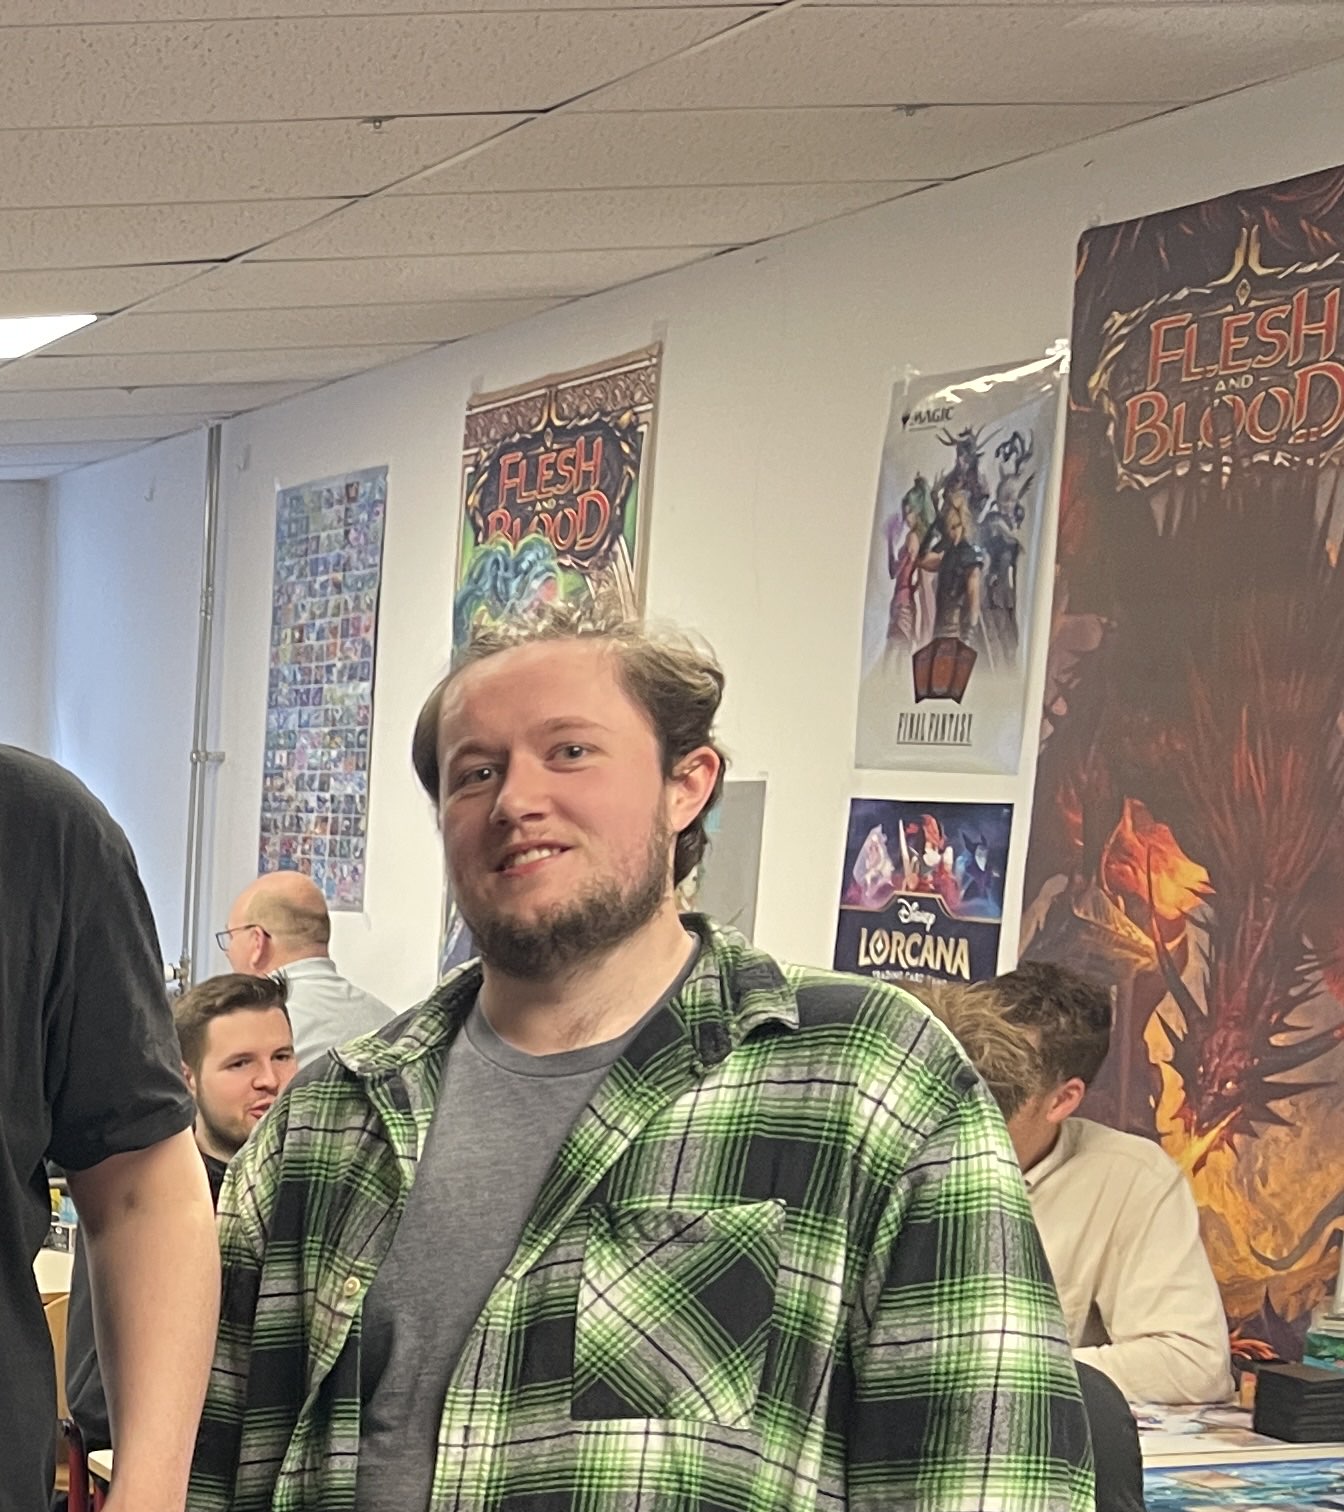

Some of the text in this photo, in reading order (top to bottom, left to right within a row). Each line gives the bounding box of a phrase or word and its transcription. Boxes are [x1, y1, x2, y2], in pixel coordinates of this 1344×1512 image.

[1146, 286, 1340, 391] FLESH
[1122, 361, 1344, 466] BLOOD
[1214, 374, 1254, 394] AND
[498, 436, 604, 509] FLESH
[897, 898, 936, 932] Disney
[858, 927, 971, 981] LORCANA
